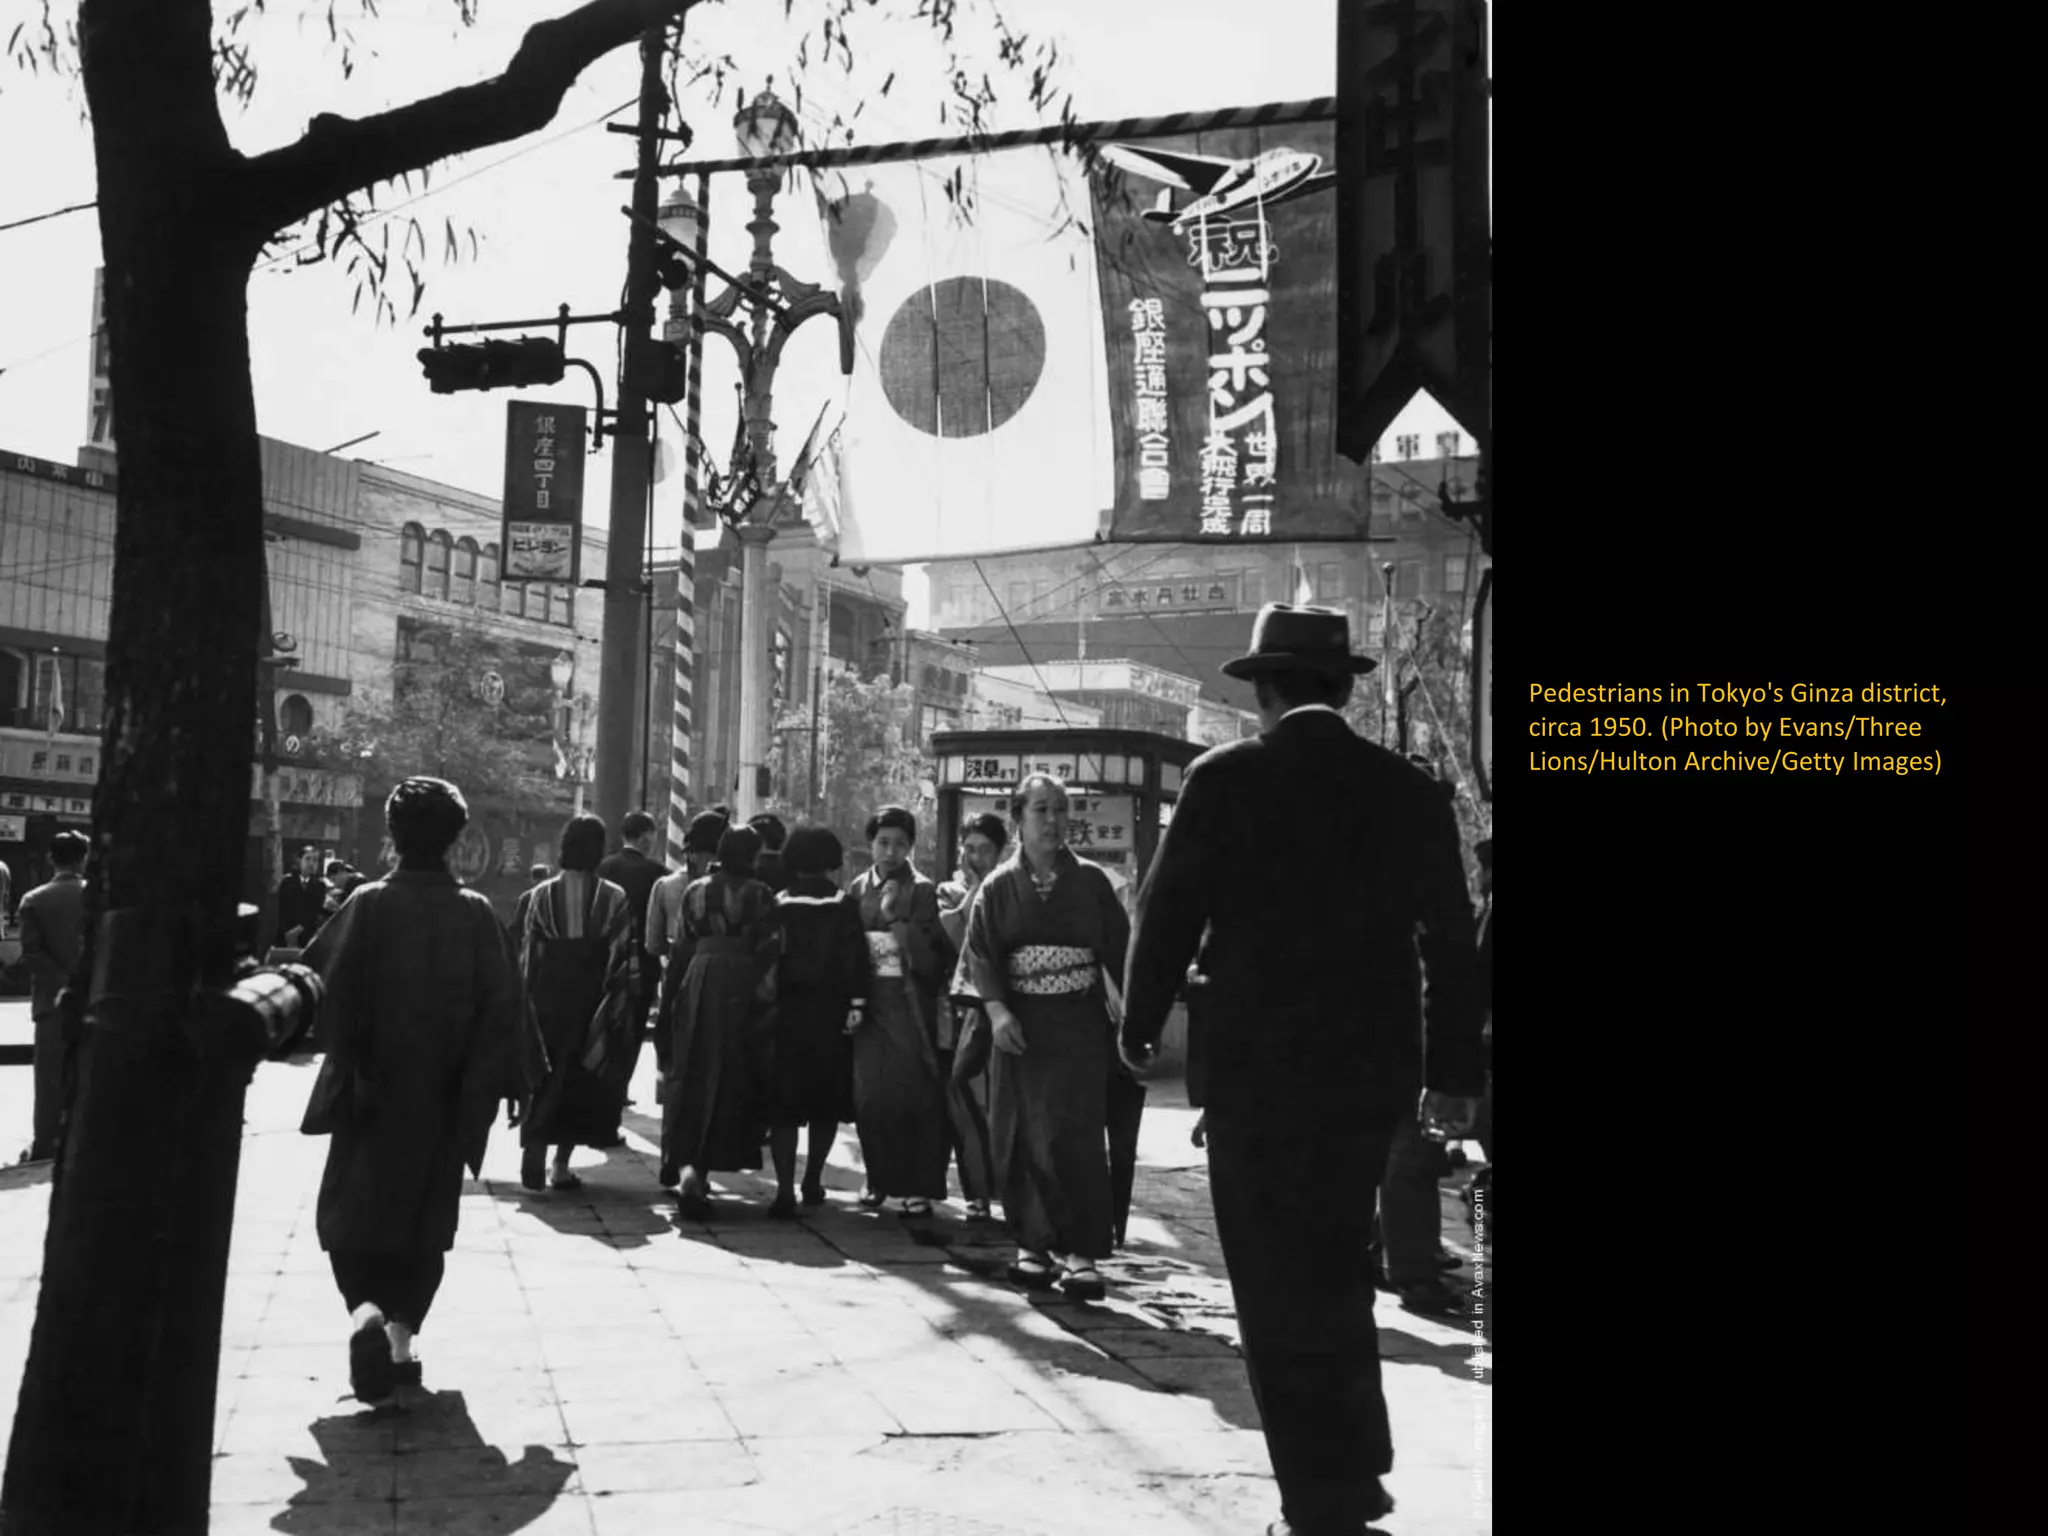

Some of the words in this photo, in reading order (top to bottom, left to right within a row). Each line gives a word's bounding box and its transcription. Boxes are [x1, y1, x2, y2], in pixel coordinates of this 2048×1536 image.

[1200, 267, 1274, 434] ニッポン
[533, 415, 556, 509] 銀座四丁目
[1240, 431, 1276, 536] 世界一周
